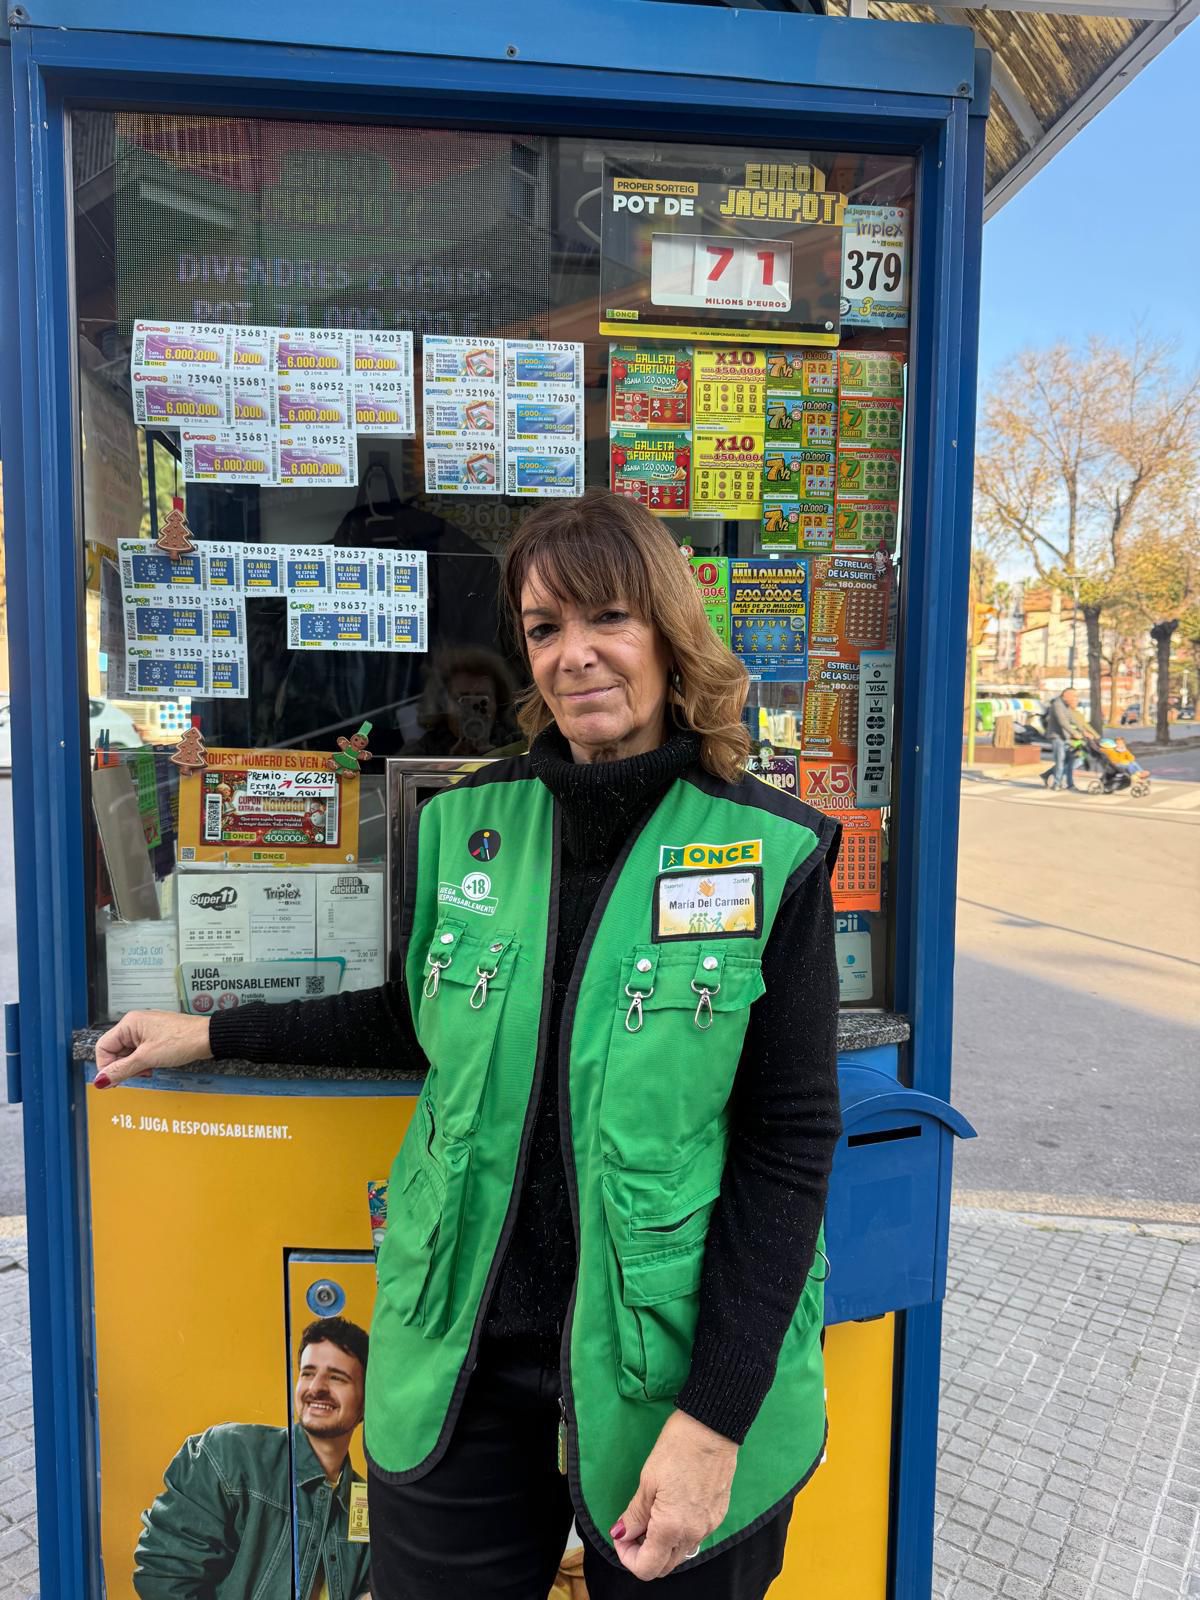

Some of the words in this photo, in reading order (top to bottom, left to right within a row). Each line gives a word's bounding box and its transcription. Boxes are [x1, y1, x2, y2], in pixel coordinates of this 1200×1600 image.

[745, 163, 812, 191] EURO
[617, 181, 653, 192] PROPER
[655, 183, 695, 194] SORTEIG
[613, 194, 659, 214] POT
[664, 198, 695, 216] DE
[720, 188, 838, 222] JACKPOT
[845, 249, 902, 292] 379
[705, 297, 745, 307] MILIONS
[747, 299, 787, 309] D'EUROS
[859, 296, 875, 317] 3
[615, 310, 638, 319] ONCE
[190, 326, 225, 335] 73940
[309, 331, 343, 340] 86952
[369, 334, 401, 343] 14203
[466, 339, 495, 347] 52196
[547, 343, 575, 351] 17630
[165, 348, 218, 361] 6.000.000
[635, 353, 676, 364] GALLETA
[715, 351, 756, 366] x10
[287, 356, 338, 369] 6.000.000
[634, 363, 675, 374] FORTUNA
[187, 374, 222, 385] 73940
[310, 382, 344, 391] 86952
[369, 382, 402, 392] 14203
[466, 388, 495, 397] 52196
[547, 394, 576, 403] 17630
[166, 402, 219, 416] 6.000.000
[802, 401, 832, 411] 10.000€
[288, 409, 340, 422] 6.000.000
[235, 432, 269, 442] 35681
[312, 436, 346, 445] 86952
[466, 442, 495, 451] 52196
[634, 440, 675, 451] GALLETA
[714, 435, 756, 452] x10
[547, 446, 576, 455] 17630
[633, 450, 674, 461] FORTUNA
[801, 452, 831, 461] 10.000€
[213, 458, 265, 473] 6.000.000
[291, 463, 343, 476] 6.000.000
[799, 503, 829, 513] 10.000€
[242, 546, 277, 556] 09802
[289, 548, 324, 557] 29425
[834, 559, 873, 570] ESTRELLAS
[731, 568, 805, 584] MILLONARIO
[828, 569, 839, 577] DE
[839, 570, 849, 578] LA
[849, 571, 877, 581] SUERTE
[838, 581, 878, 590] 180.000€
[168, 595, 201, 605] 81350
[734, 589, 802, 602] 500.000€
[333, 601, 366, 610] 98637
[169, 648, 202, 657] 81350
[827, 661, 860, 671] ESTRELLA
[820, 671, 831, 679] DE
[832, 672, 842, 680] LA
[843, 673, 860, 681] SUER
[284, 754, 297, 768] ES
[299, 756, 319, 769] VEN
[294, 772, 335, 785] 66287
[757, 773, 795, 788] ARIO
[823, 796, 857, 809] 1.000.0
[688, 844, 755, 865] ONCE
[337, 877, 359, 887] EURO
[465, 878, 486, 895] +18
[329, 885, 368, 895] JACKPOT
[697, 898, 712, 908] Del
[714, 897, 750, 907] Carmen
[191, 967, 220, 979] JUGA
[191, 976, 301, 992] RESPONSABLEMENT
[111, 1114, 136, 1130] +18.
[138, 1115, 169, 1133] JUGA
[172, 1120, 293, 1140] RESPONSABLEMENT.
